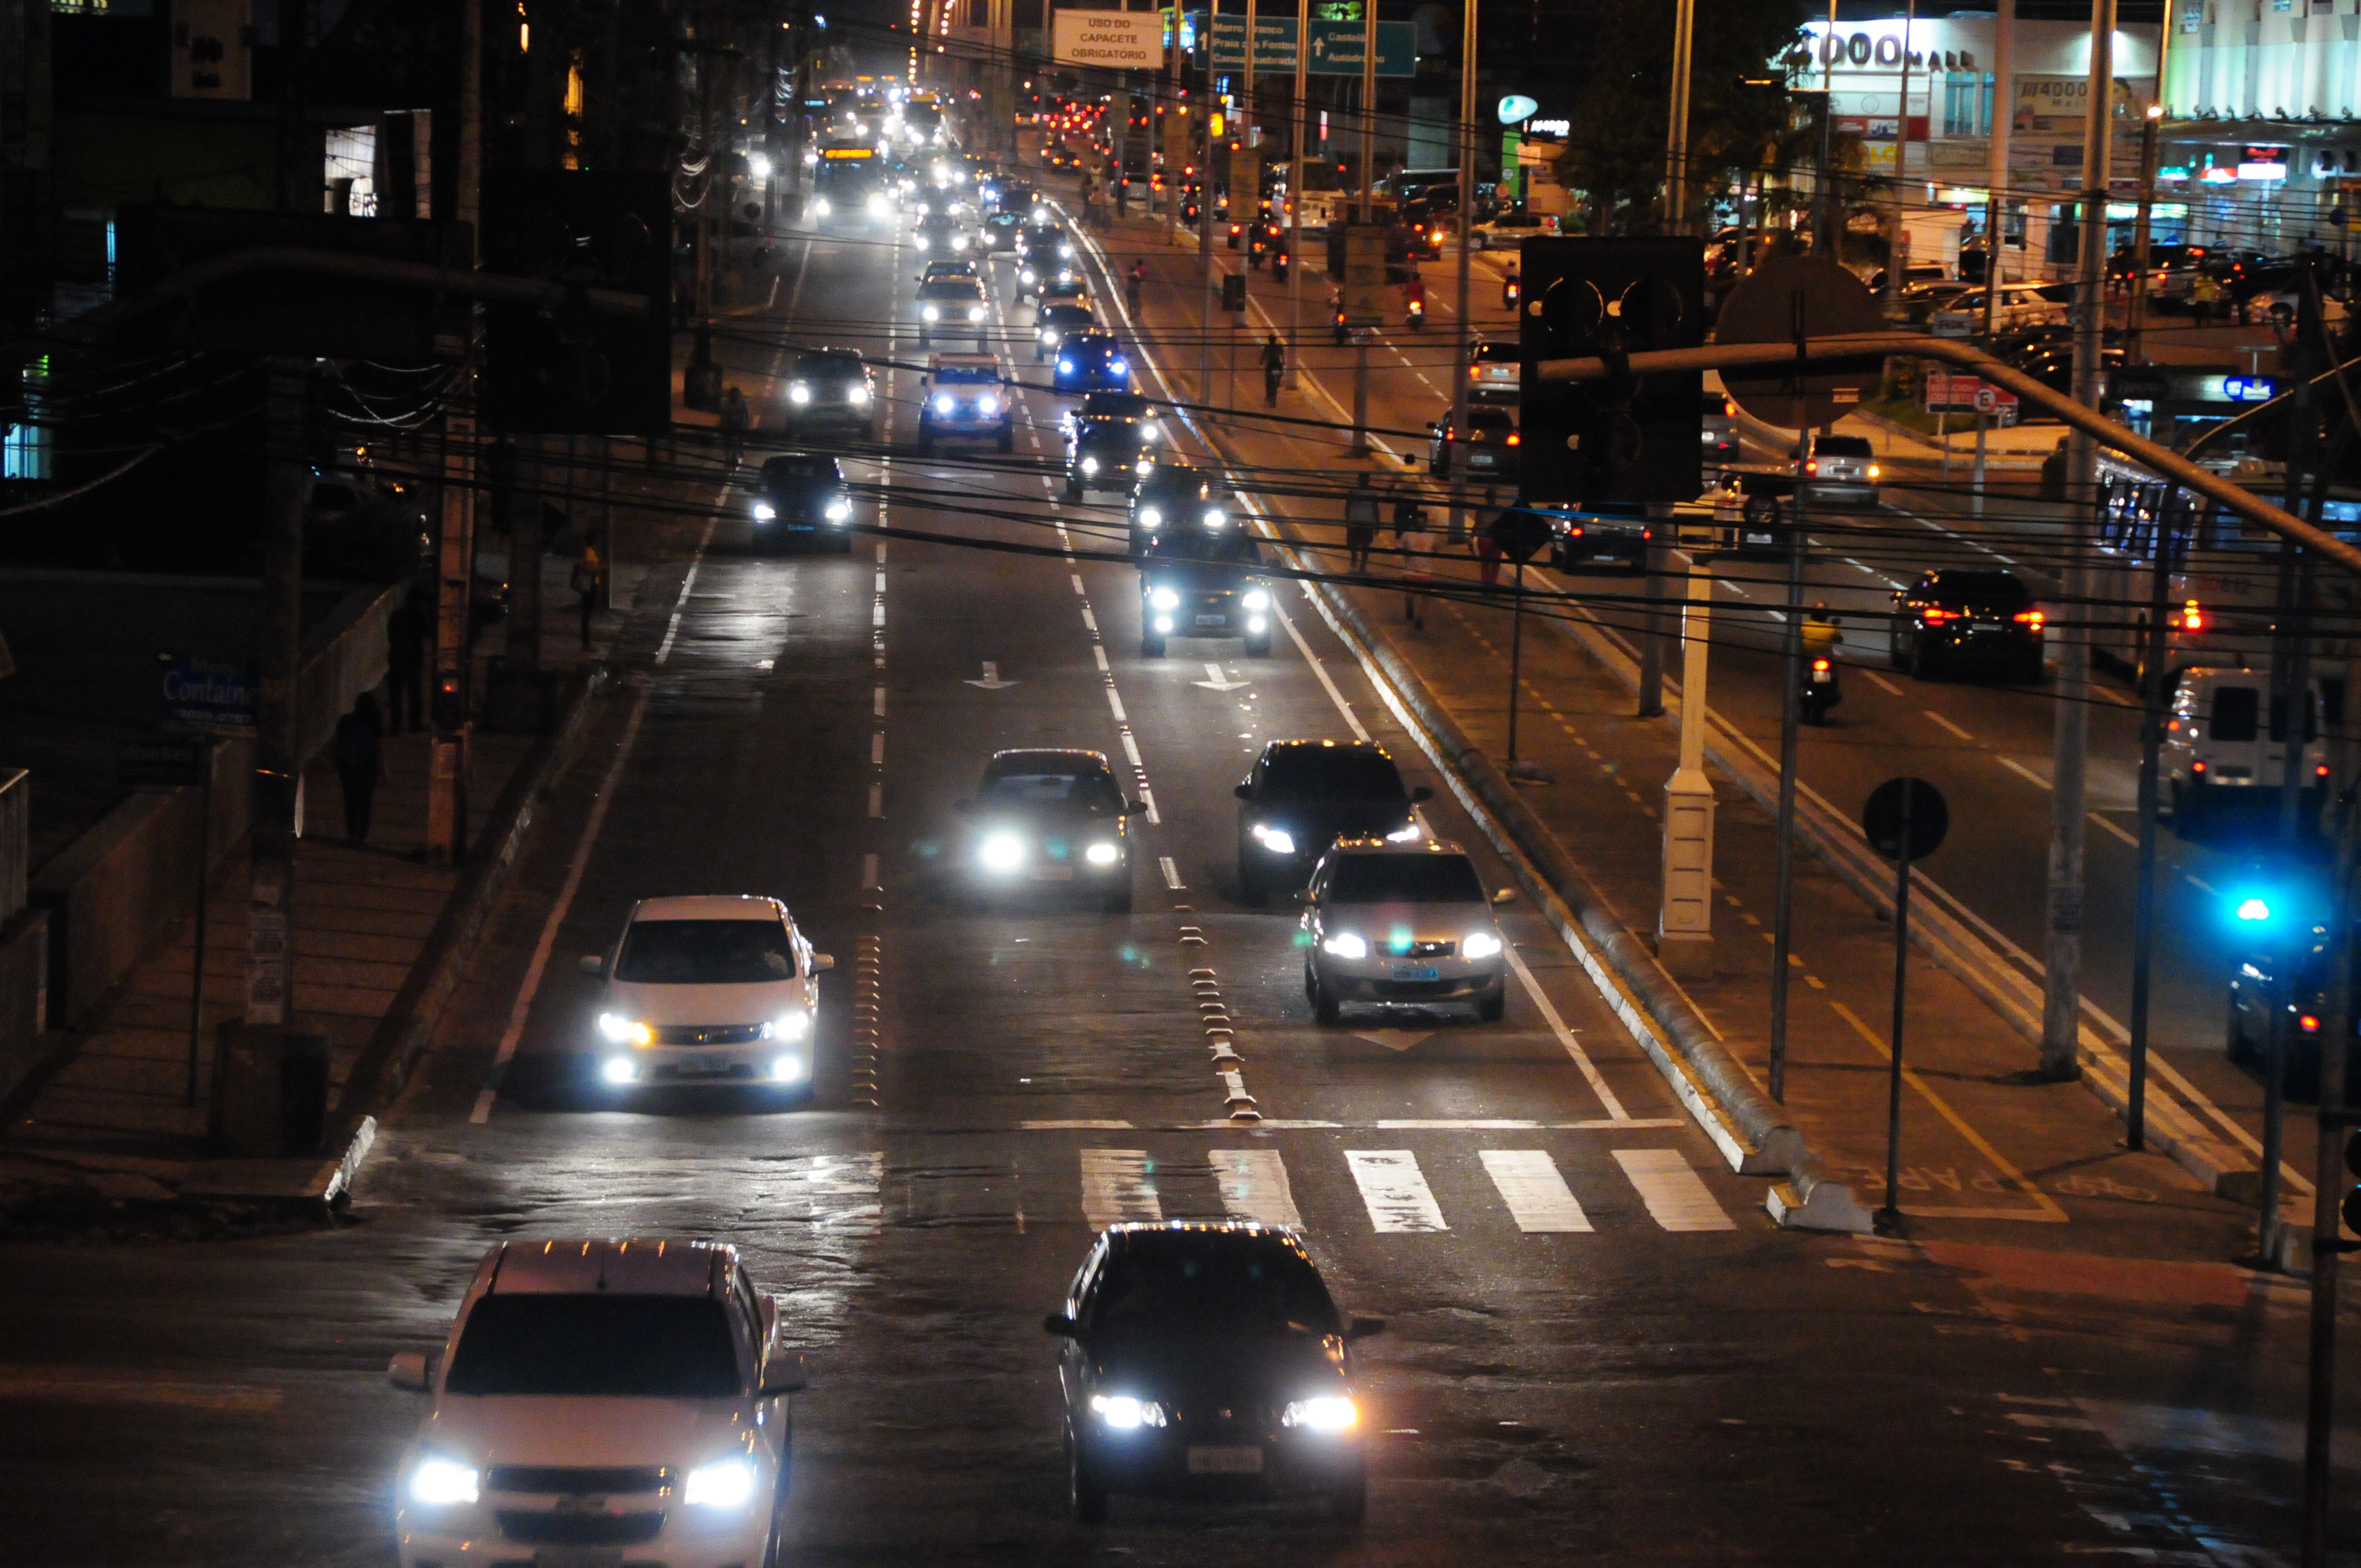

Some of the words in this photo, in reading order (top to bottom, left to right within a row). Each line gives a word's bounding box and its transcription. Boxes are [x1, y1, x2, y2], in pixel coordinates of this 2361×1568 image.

[1089, 19, 1112, 28] USO
[1114, 20, 1130, 28] DO
[1251, 25, 1284, 34] ranco
[1080, 33, 1138, 43] CAPACETE
[1212, 38, 1239, 48] Praia
[1249, 56, 1298, 66] uebrada
[163, 669, 259, 706] Containe
